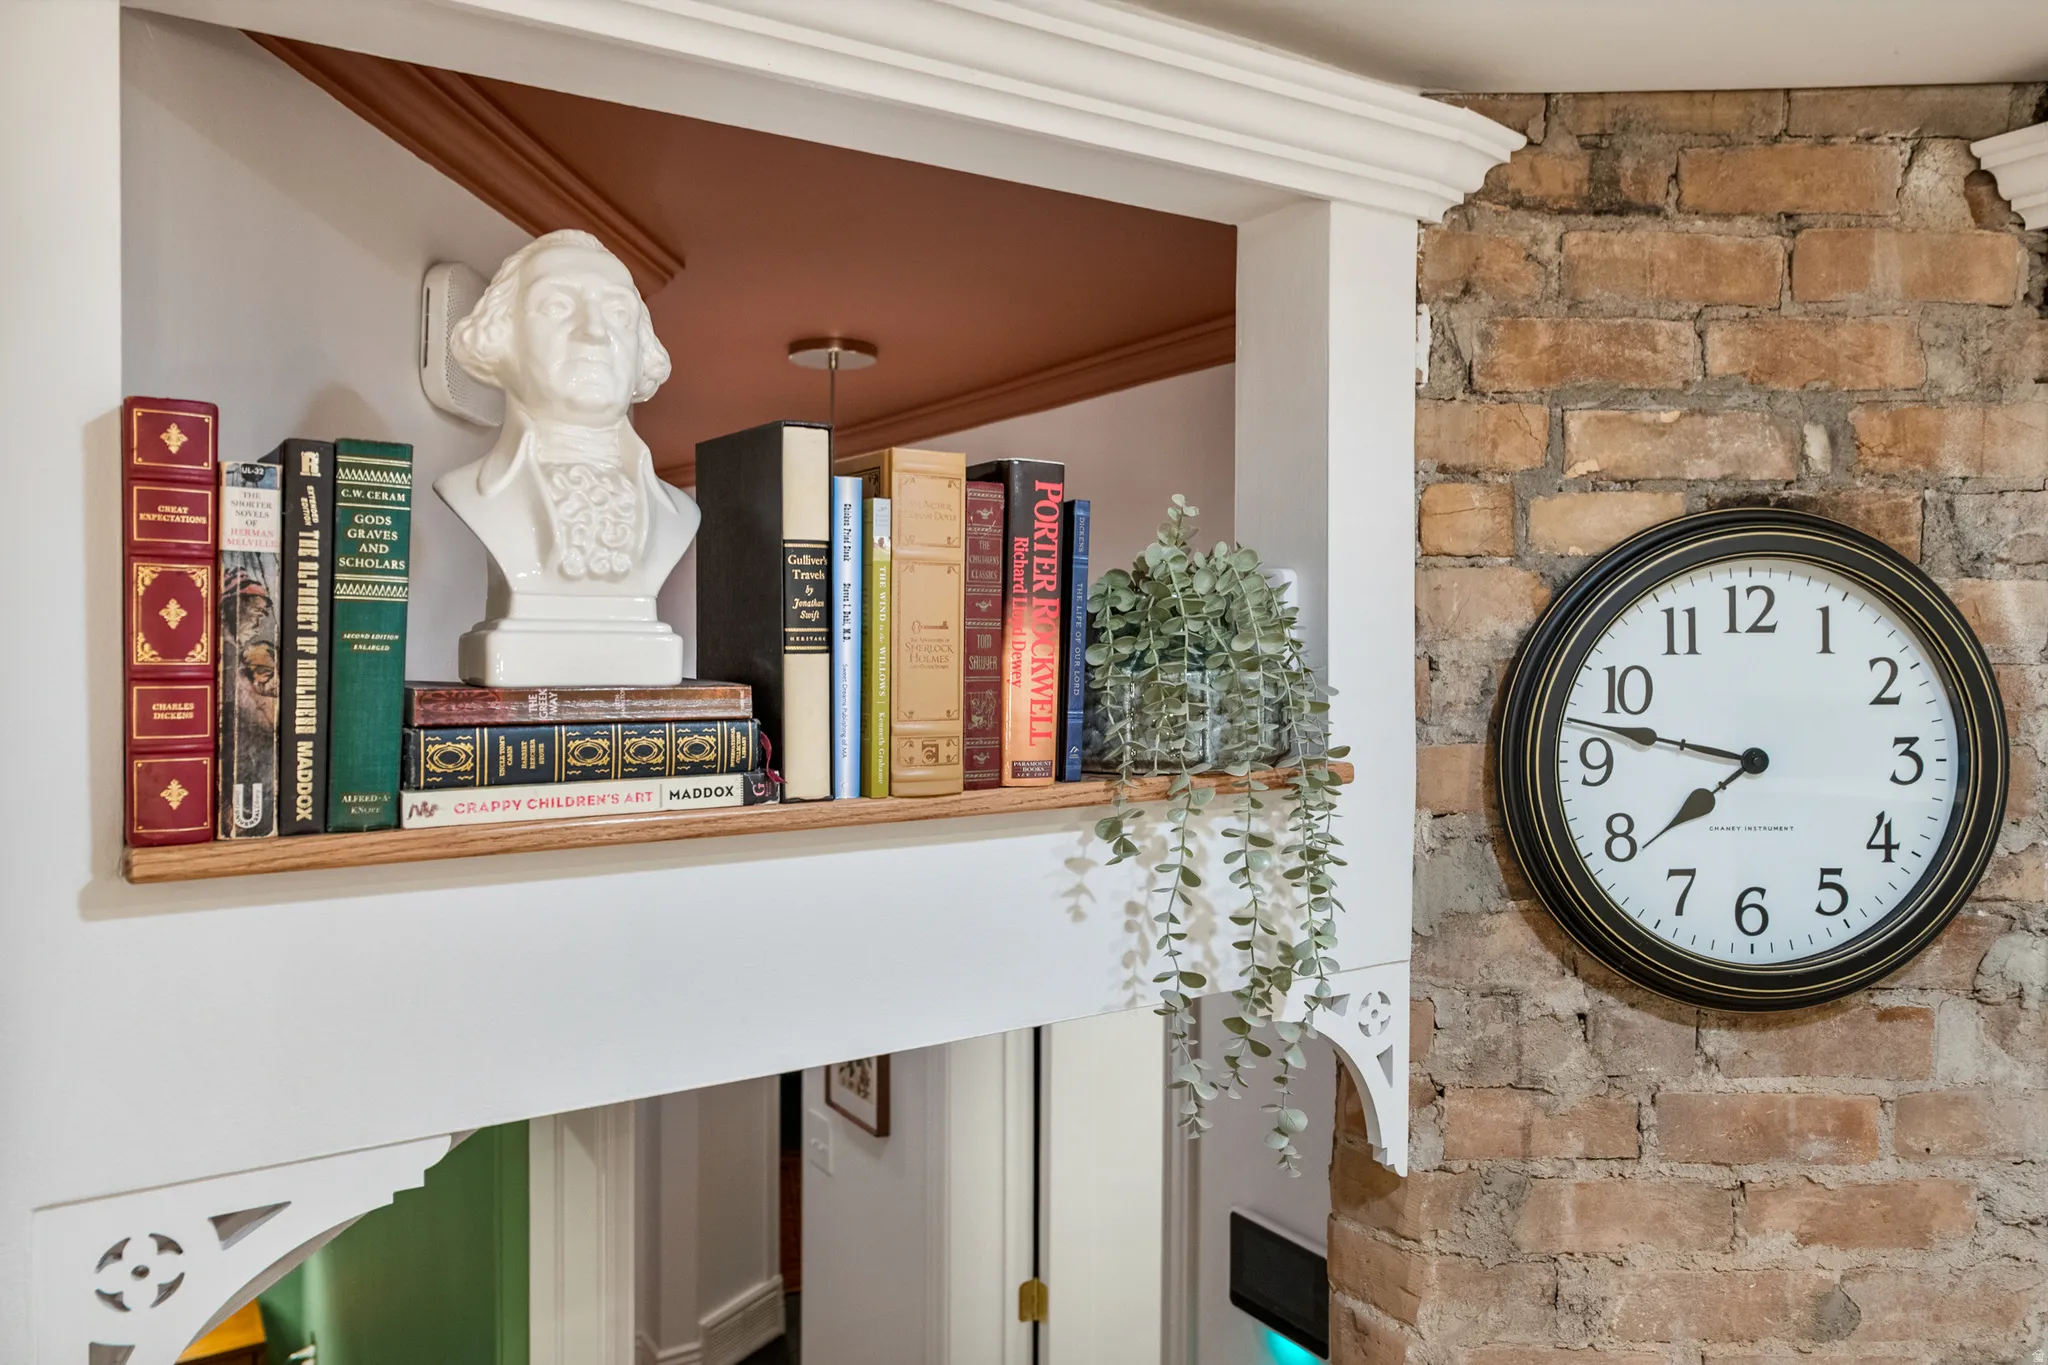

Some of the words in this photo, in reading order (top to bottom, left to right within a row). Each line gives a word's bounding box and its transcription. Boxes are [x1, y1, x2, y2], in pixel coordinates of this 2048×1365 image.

[241, 465, 264, 475] UL-32
[243, 491, 261, 499] THE
[306, 485, 319, 523] EXTENDED
[341, 488, 364, 499] C.W.
[367, 490, 405, 502] CERAM
[157, 504, 188, 514] GREAT
[231, 500, 272, 510] SHORTER
[235, 509, 269, 519] NOVELS
[301, 497, 312, 526] EDITION
[843, 503, 852, 526] Chicken
[139, 513, 207, 525] EXPECTATIONS
[354, 514, 392, 525] GODS
[227, 537, 279, 548] MELVILLE
[231, 528, 274, 538] HERMAN
[347, 528, 398, 541] GRAVES
[843, 528, 852, 543] Fried
[1032, 480, 1063, 592] PORTER
[1078, 517, 1086, 553] DICKENS
[298, 530, 320, 557] THE
[359, 542, 389, 553] AND
[843, 545, 852, 561] Steak
[979, 540, 990, 550] THE
[339, 557, 405, 570] SCHOLARS
[788, 554, 828, 565] Gulliver's
[1012, 537, 1030, 593] Richard
[792, 569, 825, 580] Travels
[879, 566, 887, 588] THE
[971, 569, 997, 579] CLASSICS
[297, 562, 320, 632] ALPHABET
[805, 585, 814, 596] by
[792, 598, 825, 609] Jonathan
[879, 591, 887, 621] WIND
[1723, 585, 1779, 634] 12
[800, 610, 820, 621] Swift
[843, 628, 851, 643] M.D.
[1075, 631, 1082, 644] OF
[1661, 606, 1702, 656] 11
[1816, 605, 1836, 654] 1
[296, 636, 318, 654] OF
[904, 642, 954, 654] SHERLOCK
[977, 634, 992, 648] TOM
[910, 653, 950, 663] HOLMES
[969, 655, 997, 670] SAWYER
[1007, 641, 1026, 687] Dewey
[878, 646, 887, 697] WILLOWS
[1029, 597, 1061, 746] ROCKWELL
[1602, 665, 1653, 715] 10
[1868, 657, 1903, 706] 2
[295, 659, 318, 734] MANLINESS
[528, 693, 537, 712] THE
[538, 688, 548, 719] GREEK
[549, 691, 558, 717] WAY
[152, 702, 194, 711] CHARLES
[153, 711, 194, 720] DICKENS
[840, 707, 848, 738] Publishing
[878, 712, 886, 745] Kenneth
[877, 748, 885, 784] Grahame
[1579, 737, 1614, 786] 9
[1889, 737, 1924, 785] 3
[296, 741, 314, 821] MADDOX
[753, 783, 765, 796] G
[341, 794, 377, 803] ALFRED
[453, 799, 522, 815] CRAPPY
[526, 793, 620, 810] CHILDREN'S
[624, 791, 654, 803] ART
[669, 785, 735, 801] MADDOX
[1605, 813, 1638, 862] 8
[1866, 811, 1900, 862] 4
[1667, 868, 1697, 917] 7
[1815, 867, 1849, 917] 5
[1734, 887, 1769, 936] 6
